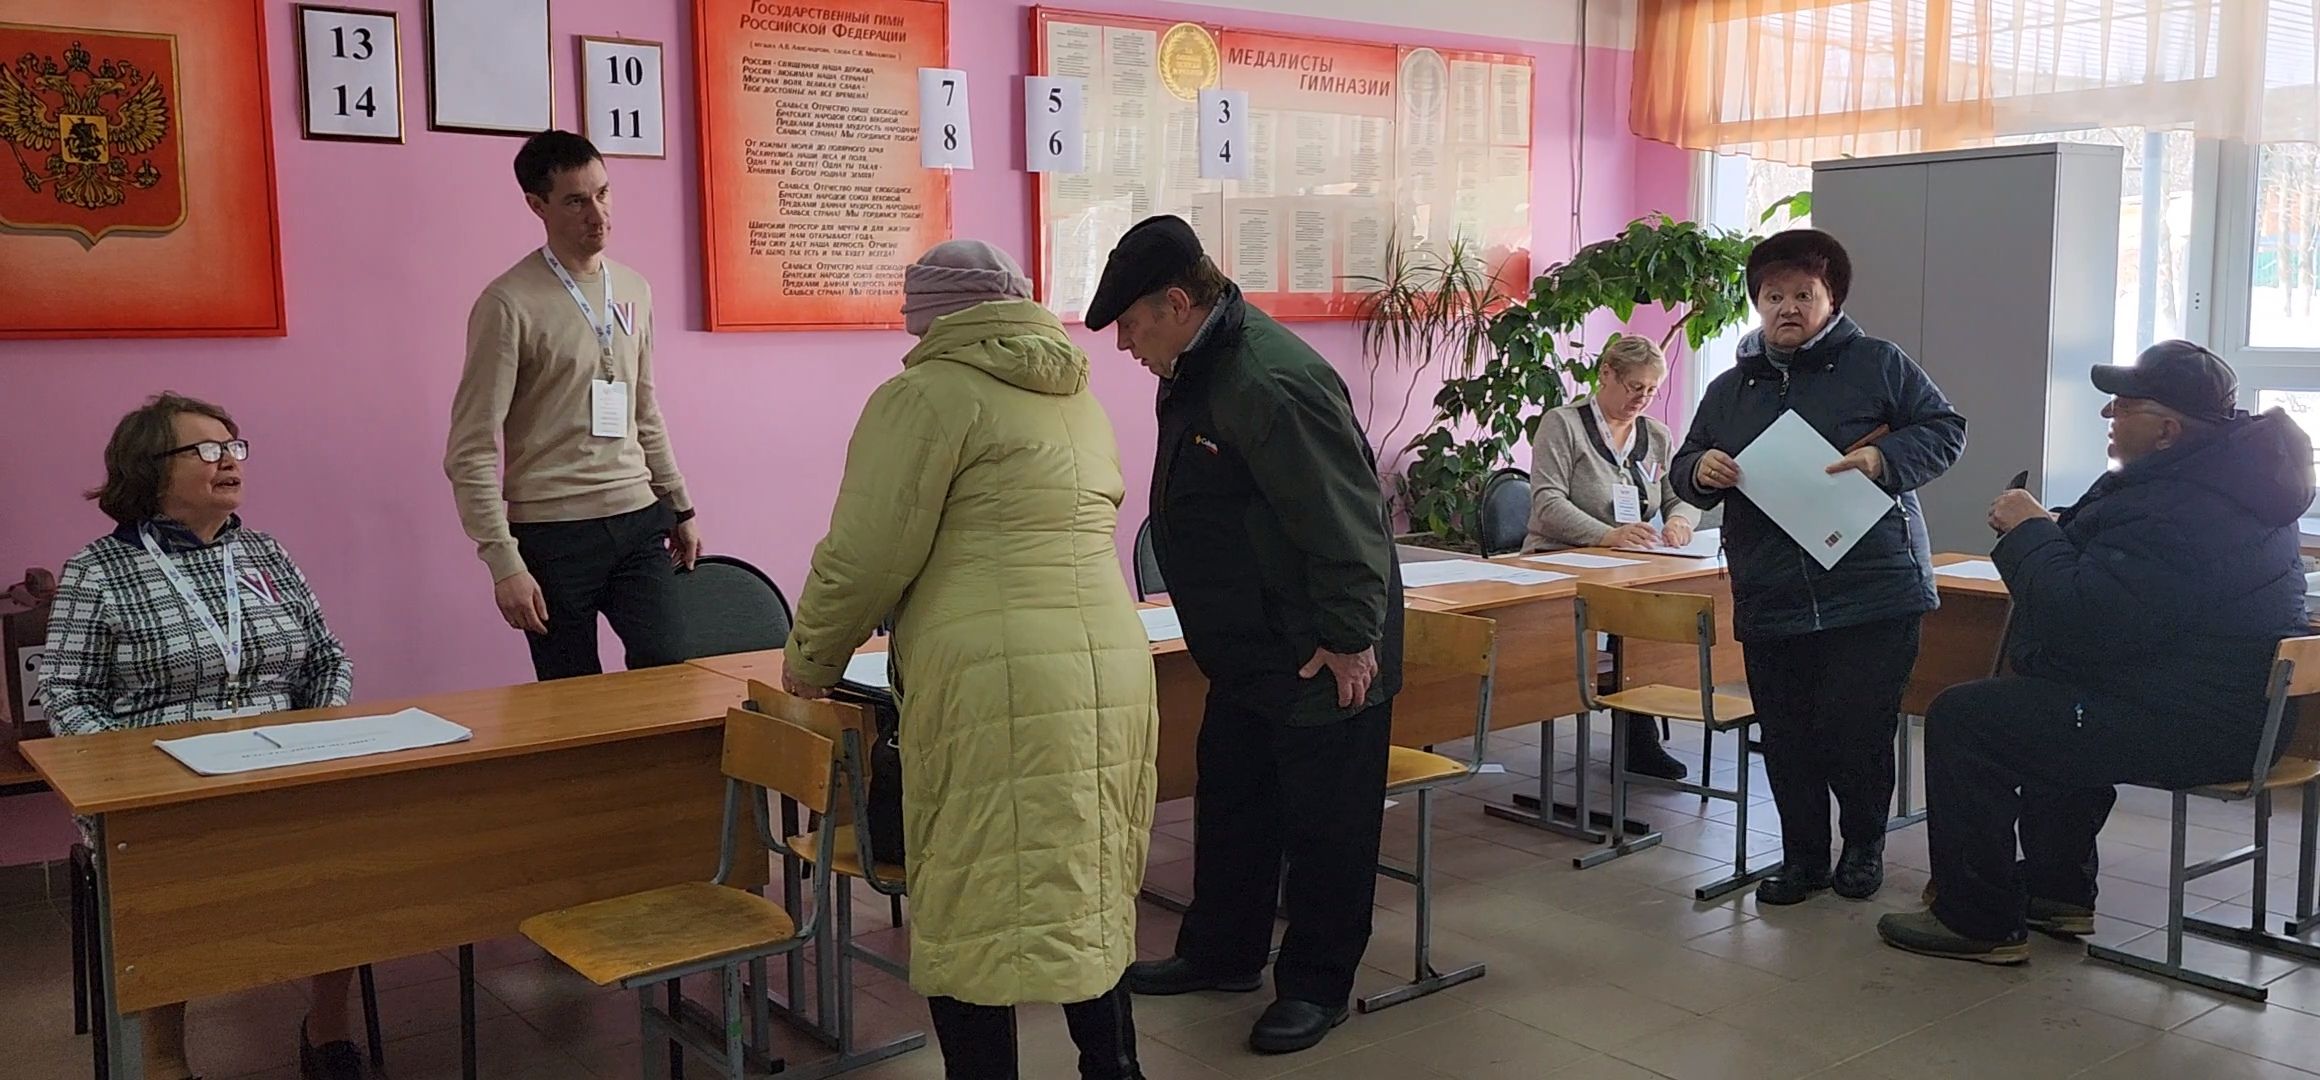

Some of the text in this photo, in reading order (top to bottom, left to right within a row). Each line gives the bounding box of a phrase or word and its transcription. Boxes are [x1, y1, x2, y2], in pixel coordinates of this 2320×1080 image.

[750, 0, 869, 24] ГОСУДАРСТВЕННЫЙ
[740, 14, 906, 43] РОССИЙСКОЙ ФЕДЕРАЦИИ
[330, 26, 373, 60] 13
[606, 55, 643, 86] 10
[1228, 47, 1334, 73] МЕДАЛИСТЫ
[941, 80, 955, 107] 7
[1300, 74, 1391, 97] ГИМНАЗИИ
[333, 84, 376, 118] 14
[1048, 88, 1062, 113] 5
[1218, 100, 1231, 124] 3
[609, 108, 643, 138] 11
[943, 123, 958, 151] 8
[1049, 130, 1062, 156] 6
[1219, 140, 1232, 163] 4
